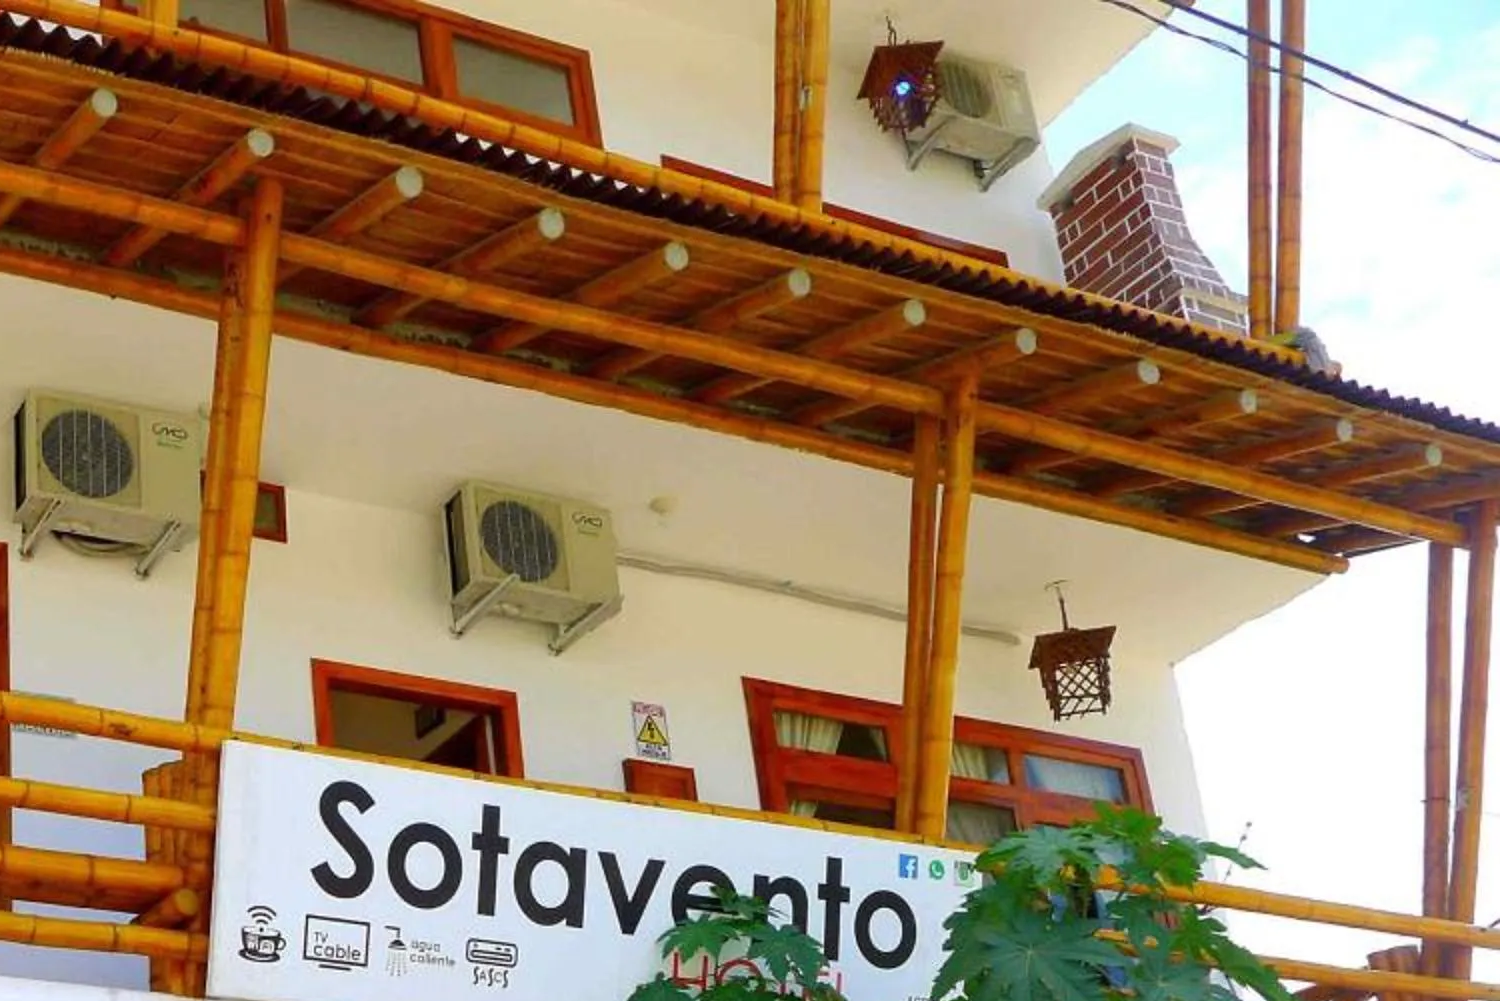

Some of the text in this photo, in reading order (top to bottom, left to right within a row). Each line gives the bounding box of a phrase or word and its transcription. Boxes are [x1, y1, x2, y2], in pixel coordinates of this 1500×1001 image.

[310, 780, 918, 970] Sotavento
[314, 932, 329, 943] TV
[313, 944, 361, 961] cable
